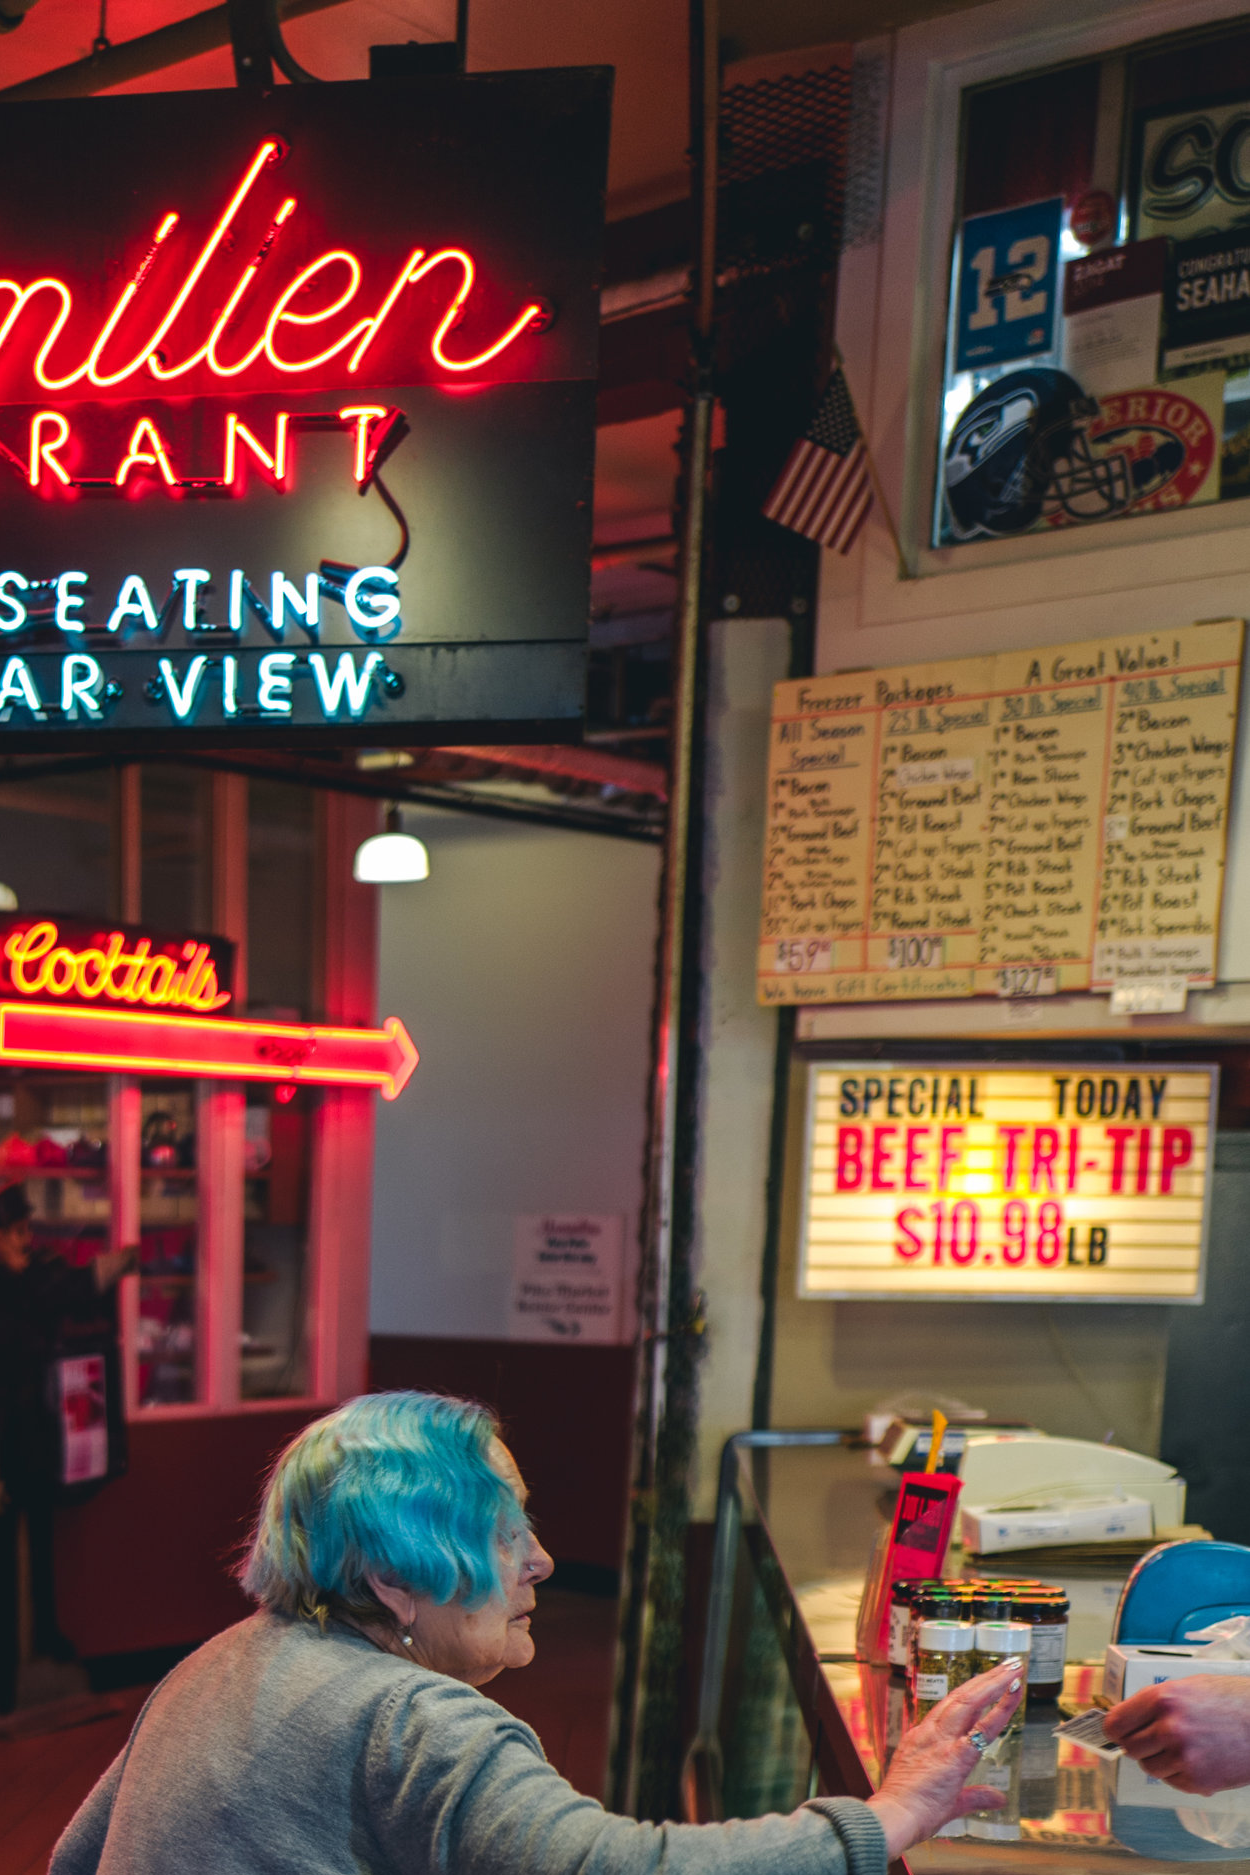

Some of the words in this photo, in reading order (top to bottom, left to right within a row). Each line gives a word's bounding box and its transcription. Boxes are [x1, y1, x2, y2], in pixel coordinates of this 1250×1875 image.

[969, 235, 1048, 331] 12
[160, 650, 387, 720] VIEW
[1025, 659, 1041, 686] A
[1052, 655, 1104, 683] Great
[2, 920, 232, 1013] Cocktails
[839, 1077, 984, 1119] SPECIAL
[1054, 1077, 1168, 1120] TODAY
[835, 1125, 965, 1194] BEEF
[998, 1125, 1195, 1196] TRI-TIP
